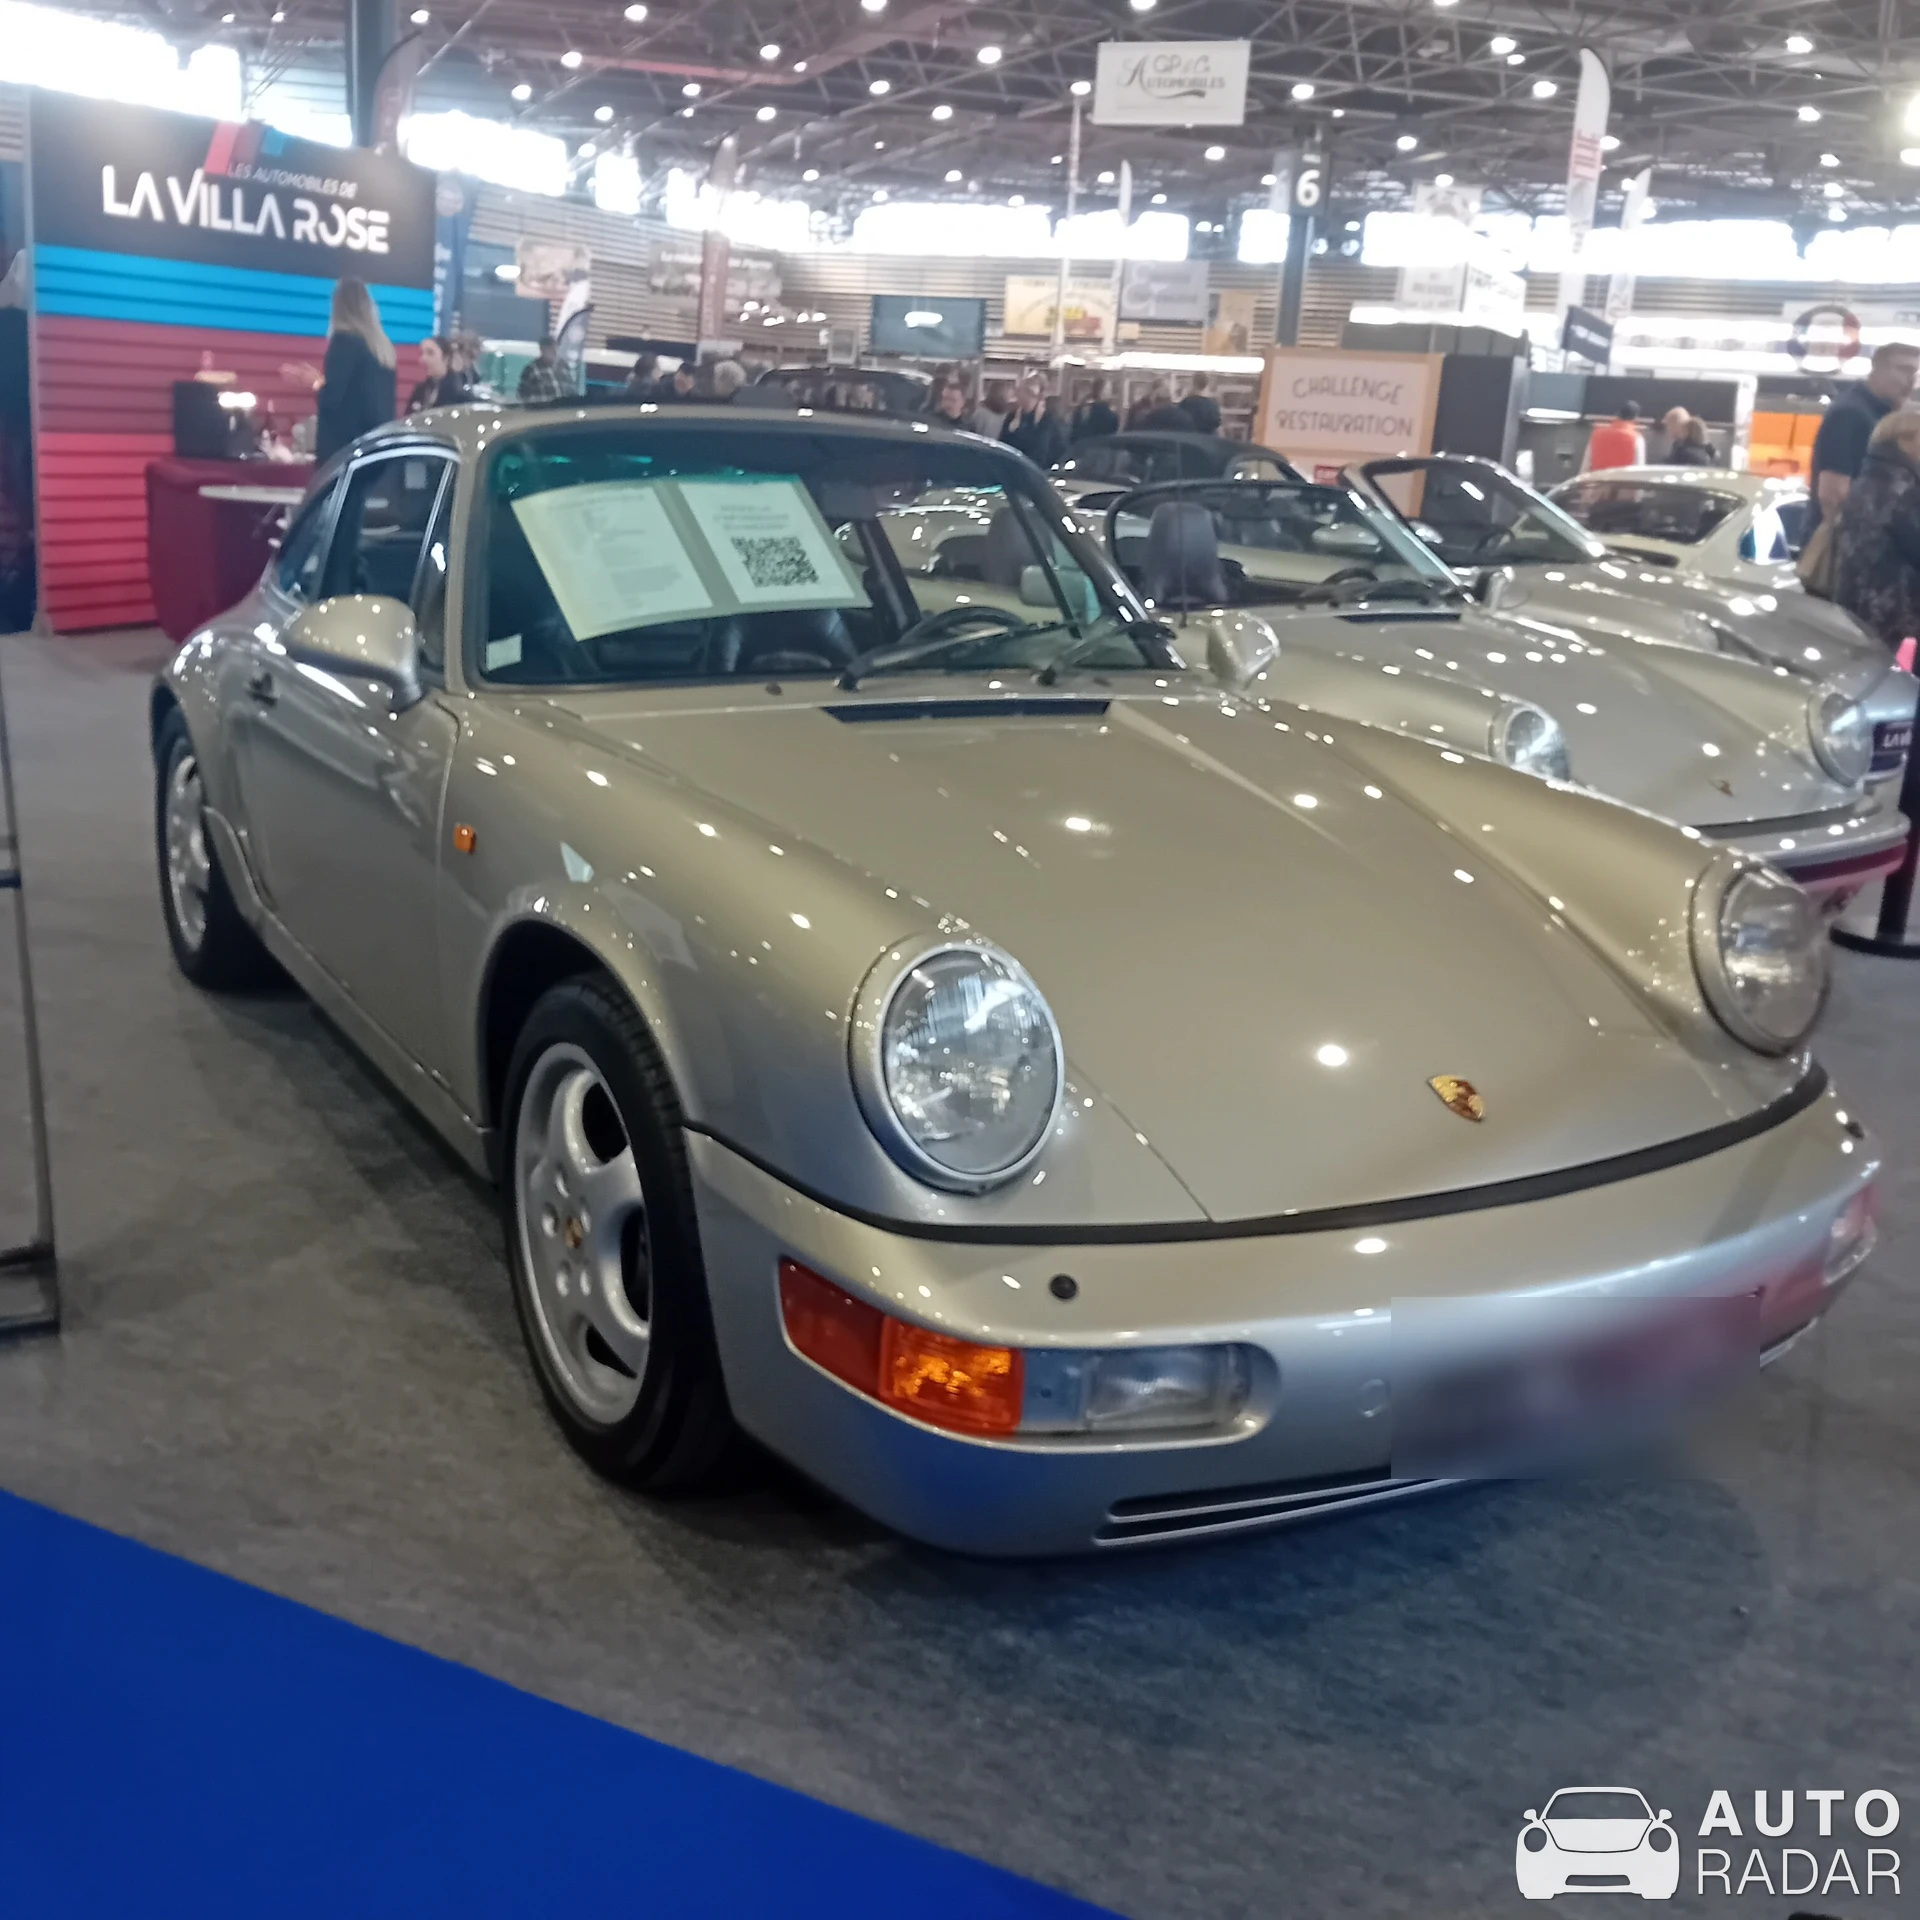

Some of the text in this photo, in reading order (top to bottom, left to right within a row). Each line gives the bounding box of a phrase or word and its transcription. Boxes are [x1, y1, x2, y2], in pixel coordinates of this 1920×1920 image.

[227, 161, 358, 199] LES AUTOMOBILES DE
[1296, 169, 1321, 208] 6
[102, 164, 389, 254] LA VILLA ROSE
[1292, 375, 1406, 406] CHALLENGE
[1275, 408, 1414, 437] RESTAURATION
